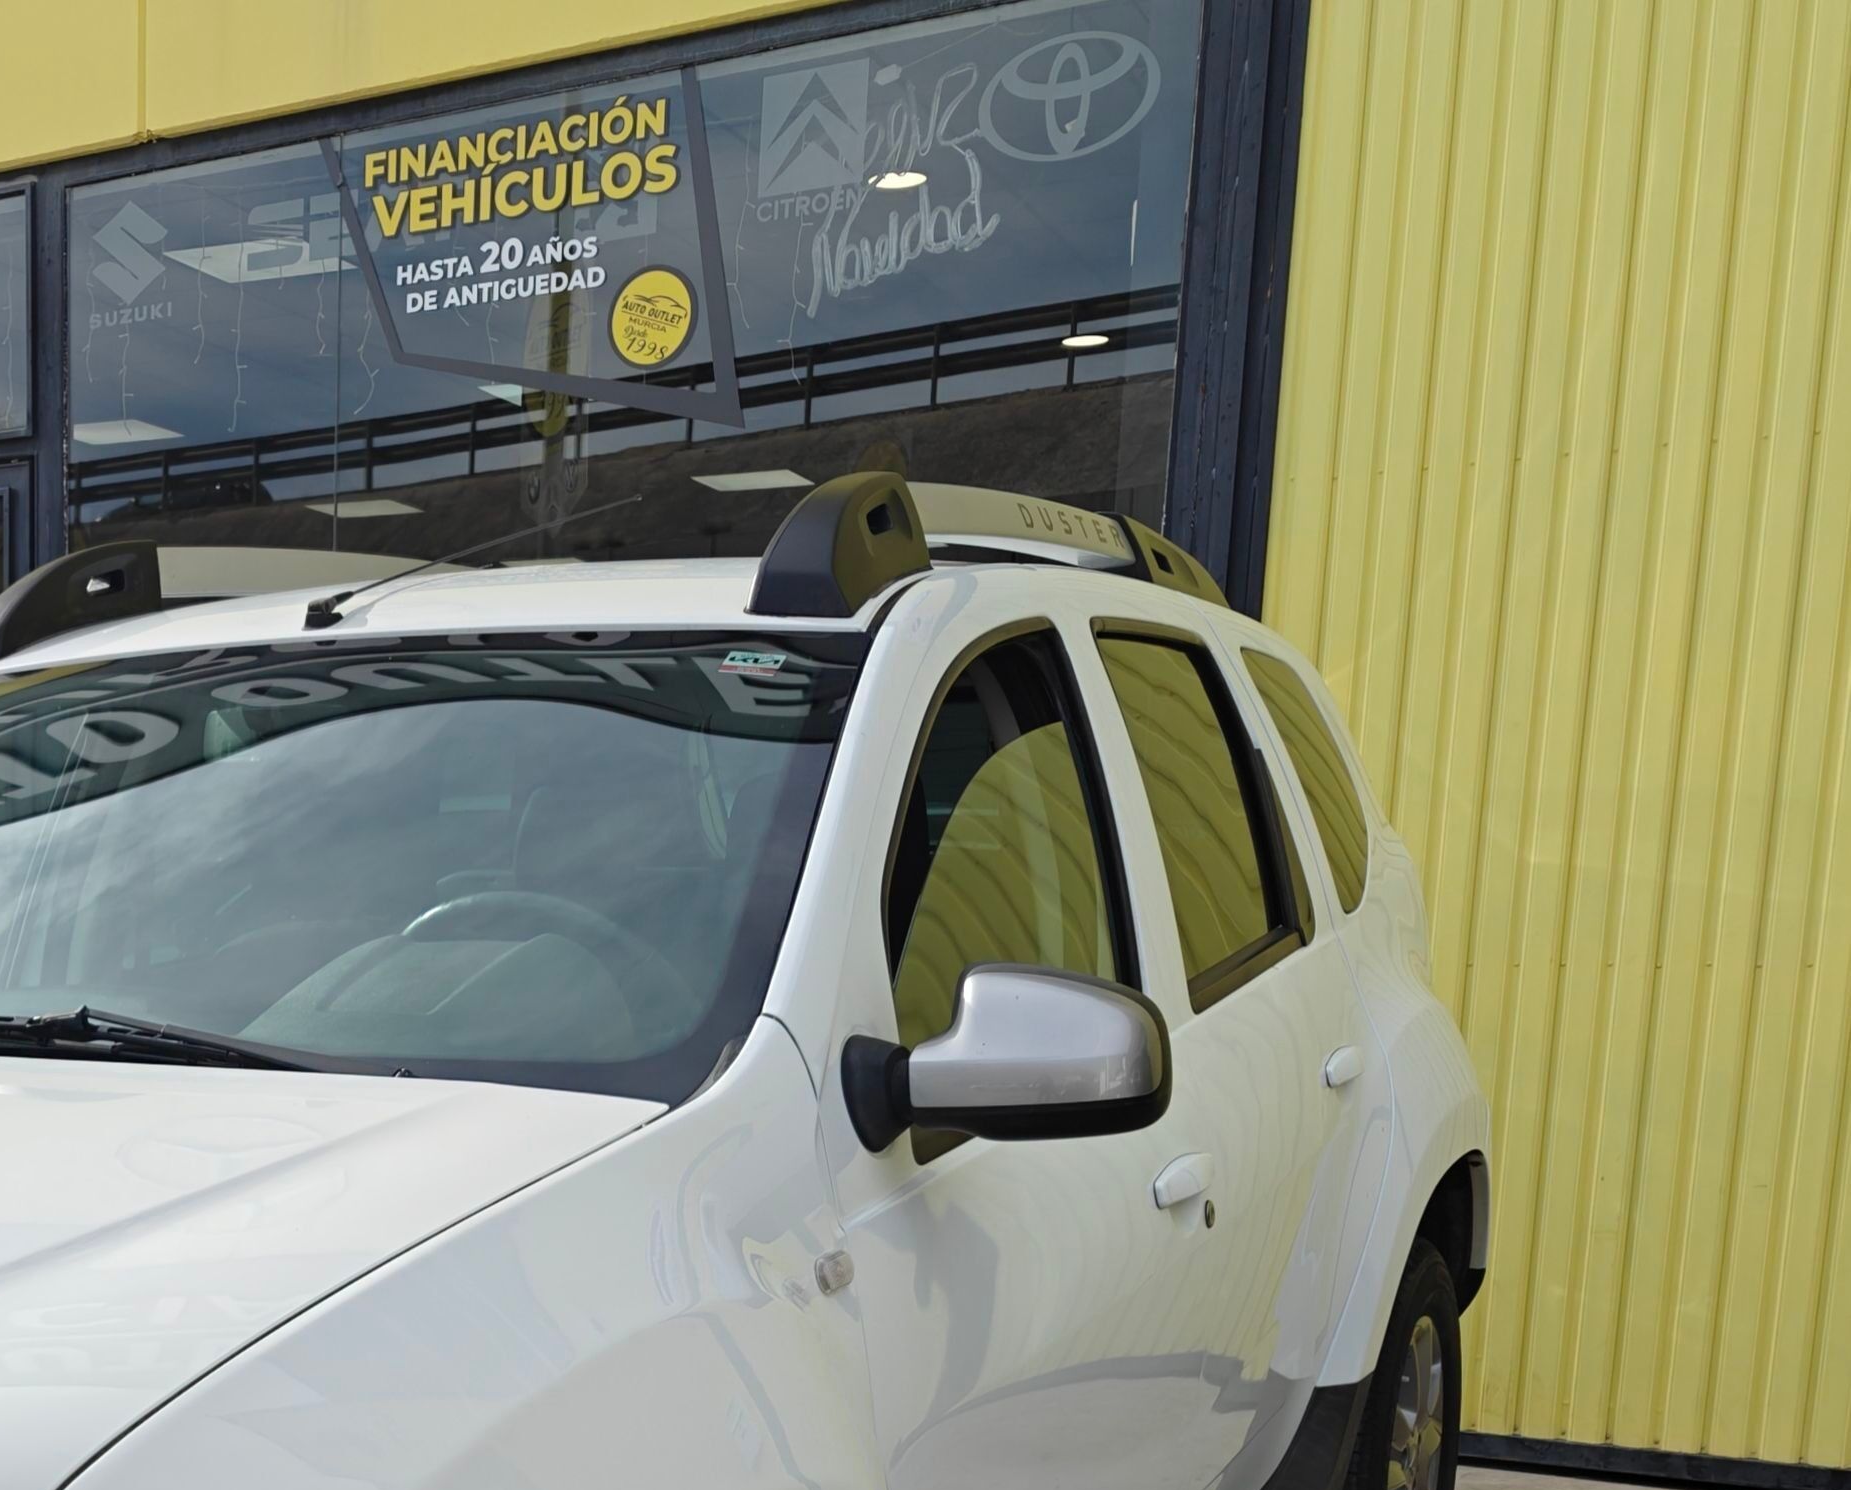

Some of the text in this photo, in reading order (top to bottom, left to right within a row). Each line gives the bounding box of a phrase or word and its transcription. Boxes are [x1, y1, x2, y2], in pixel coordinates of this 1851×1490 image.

[363, 95, 668, 189] FINANCIACIÓN
[371, 143, 678, 239] VEHÍCULOS
[395, 236, 598, 286] HASTA 20 AÑOS
[405, 266, 606, 313] DE ANTIGUEDAD
[622, 300, 683, 326] AUTO OUTLET
[89, 301, 173, 330] SUZUKI
[628, 315, 667, 333] MURCIA
[626, 336, 669, 360] 1998
[1016, 502, 1126, 550] DUSTER
